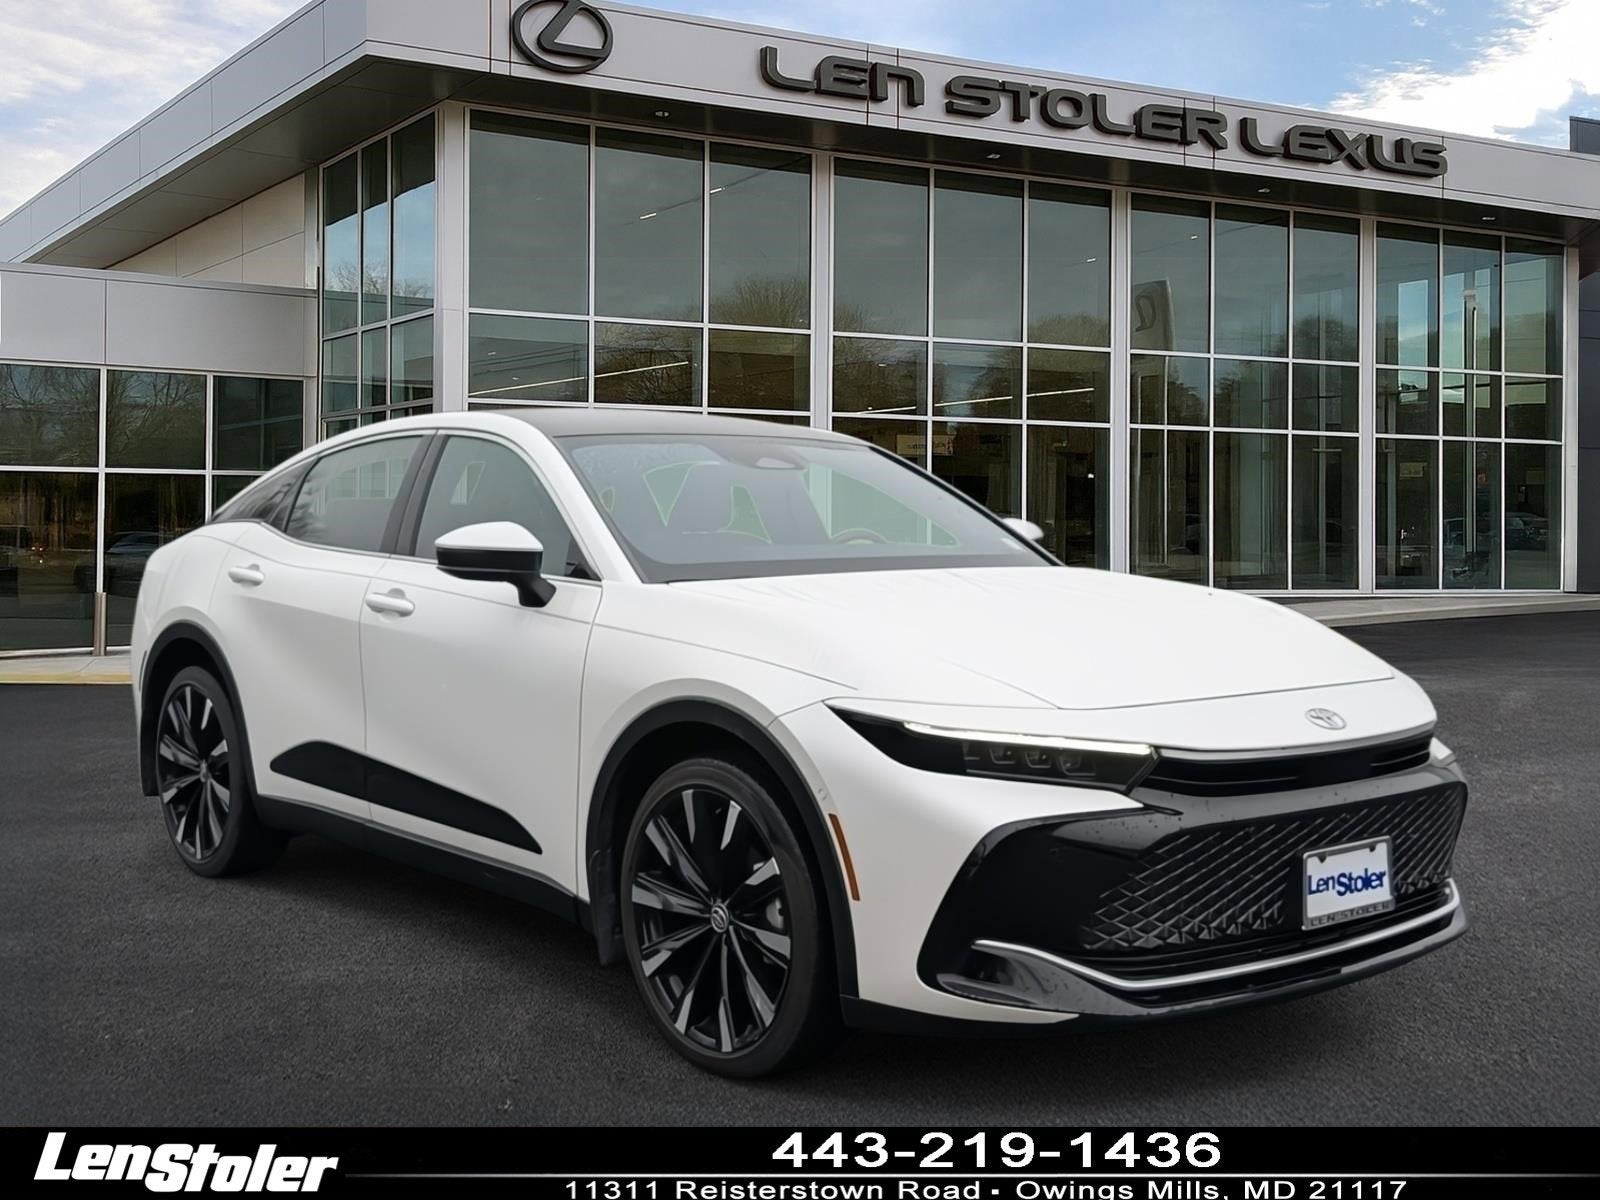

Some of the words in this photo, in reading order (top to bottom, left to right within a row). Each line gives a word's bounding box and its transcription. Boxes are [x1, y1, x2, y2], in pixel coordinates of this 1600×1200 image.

[760, 46, 925, 106] LEN
[945, 76, 1228, 149] STOLER
[1240, 116, 1448, 178] LEXUS
